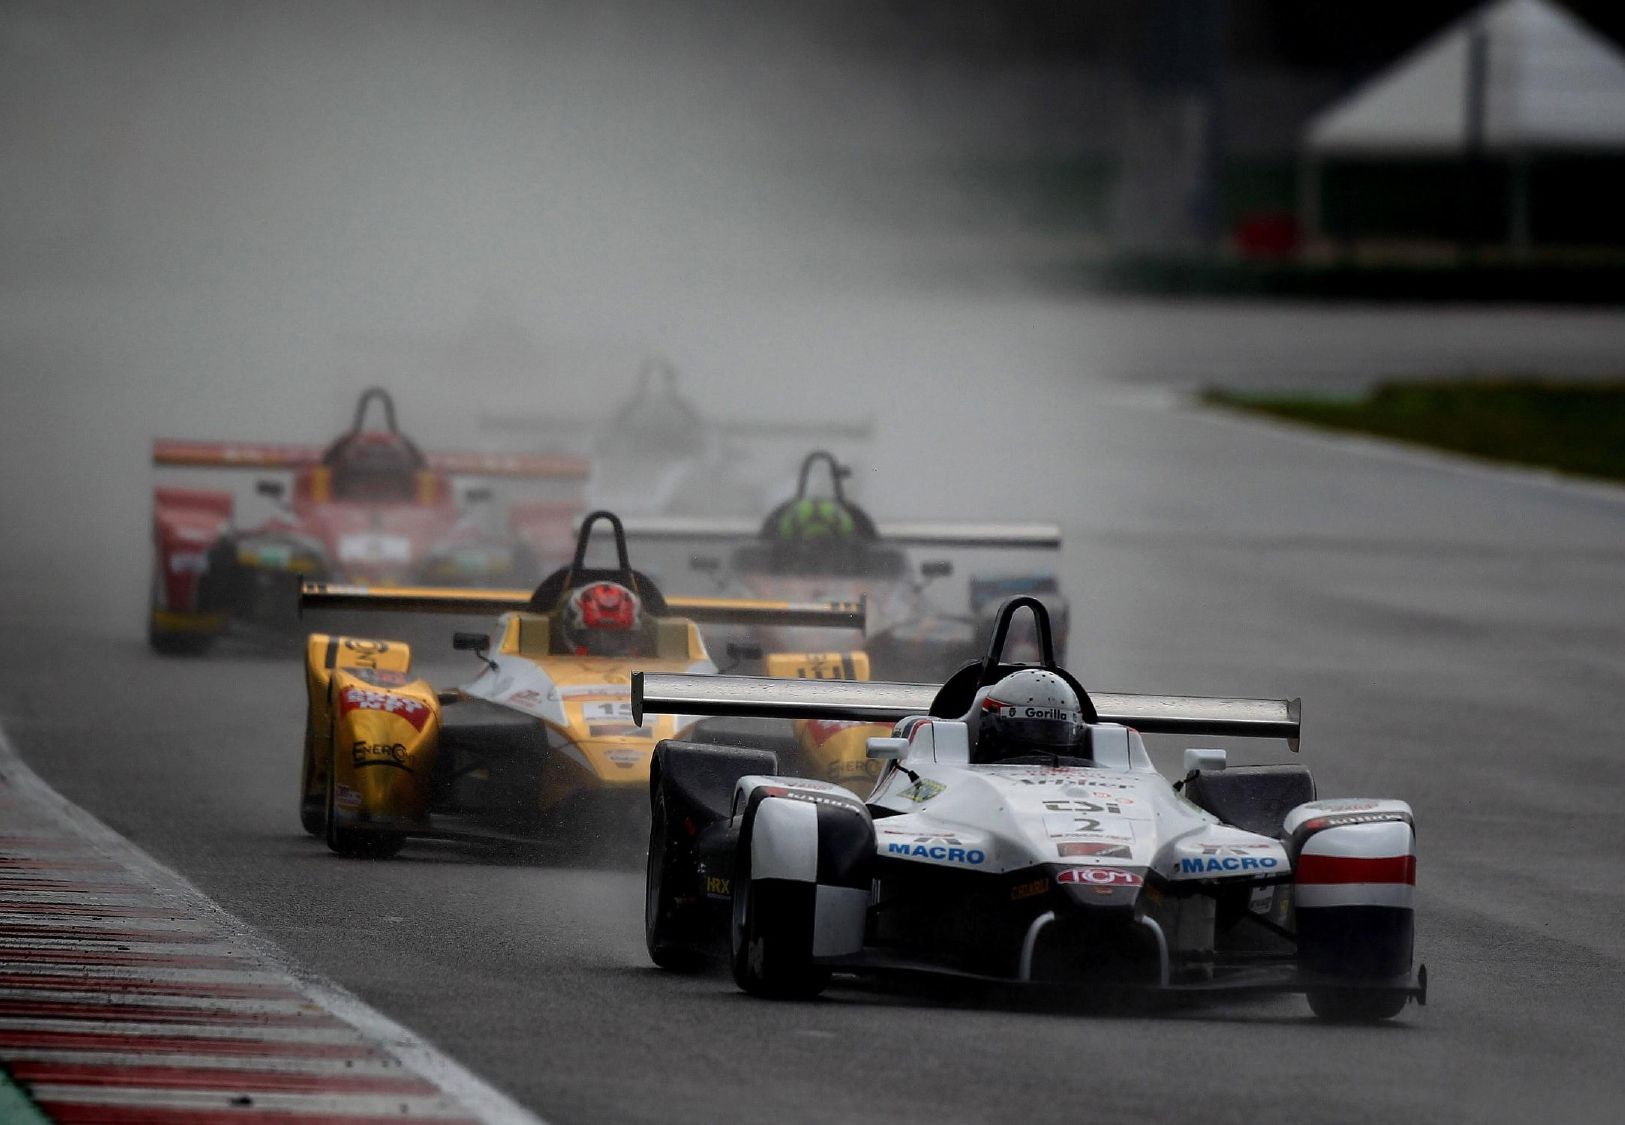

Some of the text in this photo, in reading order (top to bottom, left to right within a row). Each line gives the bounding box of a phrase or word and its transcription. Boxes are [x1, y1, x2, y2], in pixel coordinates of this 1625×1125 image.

[1025, 708, 1067, 720] Gorilla
[1074, 818, 1104, 832] 2
[889, 843, 985, 865] MACRO
[1181, 857, 1278, 873] MACRO
